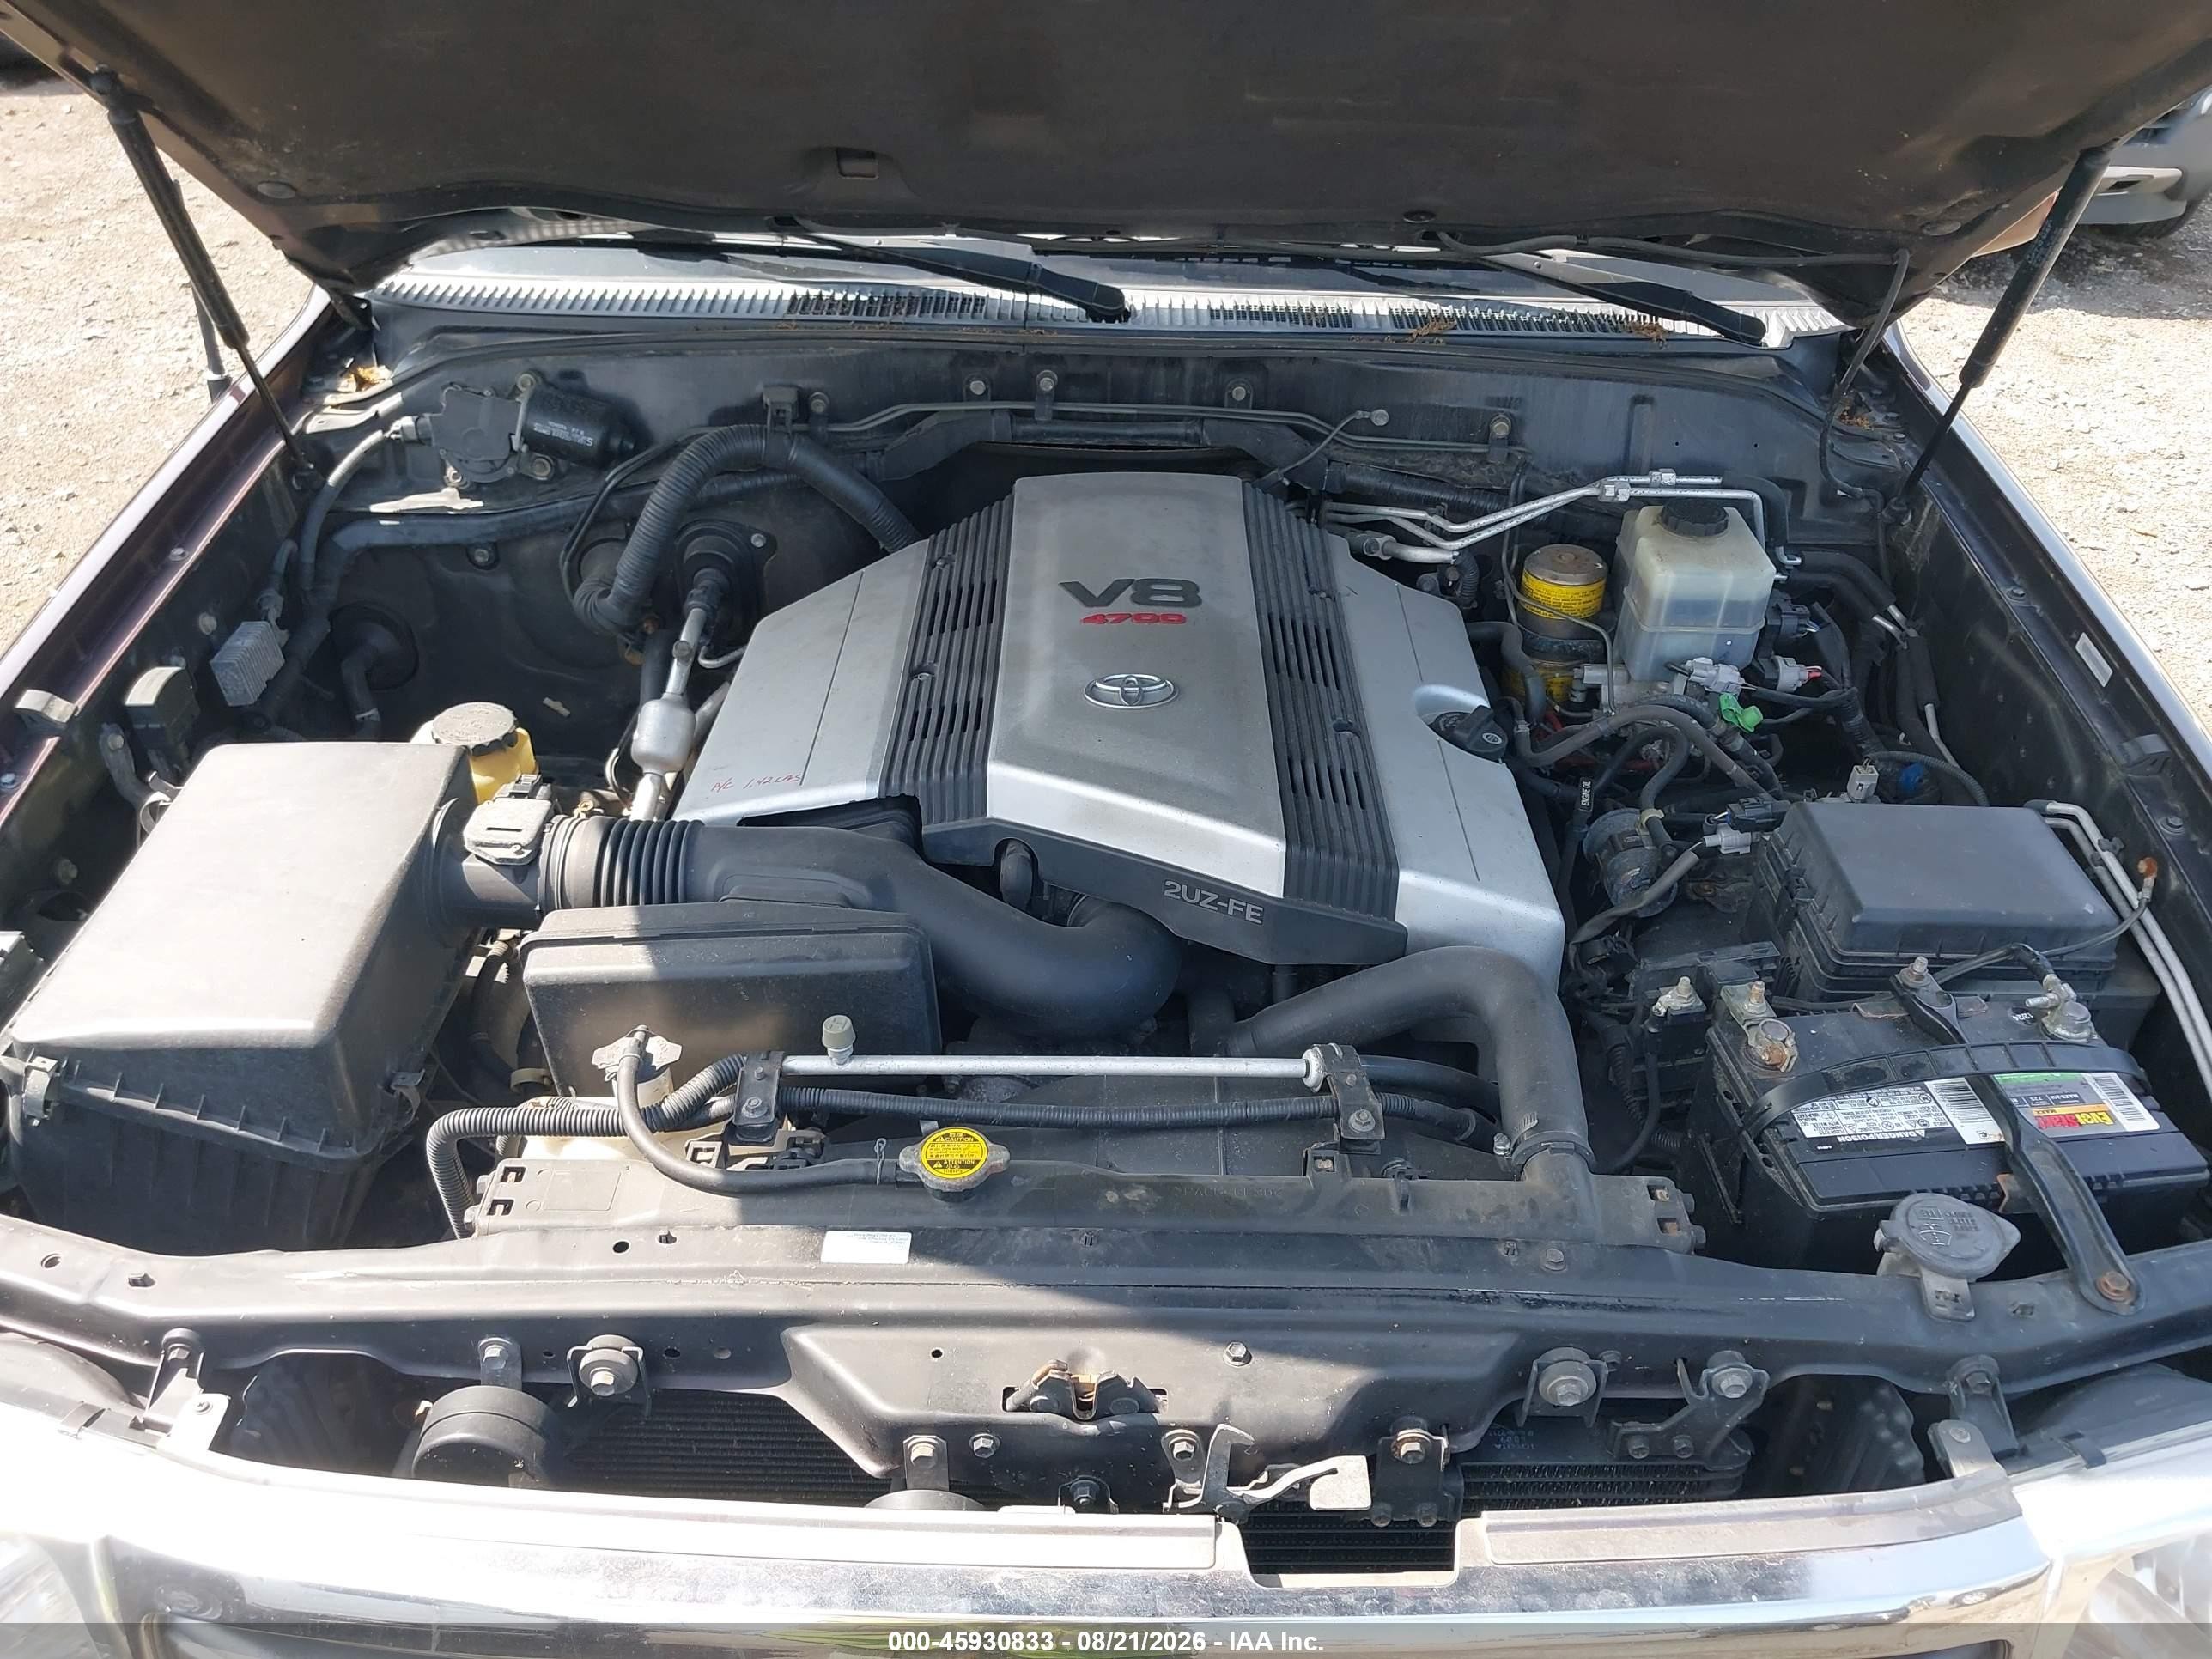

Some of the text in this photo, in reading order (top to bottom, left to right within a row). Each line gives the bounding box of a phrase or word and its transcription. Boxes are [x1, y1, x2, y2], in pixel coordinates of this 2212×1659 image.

[1058, 578, 1203, 608] V8
[1080, 612, 1187, 625] 4700
[1164, 879, 1264, 925] 2UZ-FE
[1836, 1131, 1917, 1143] DANGER/POISON
